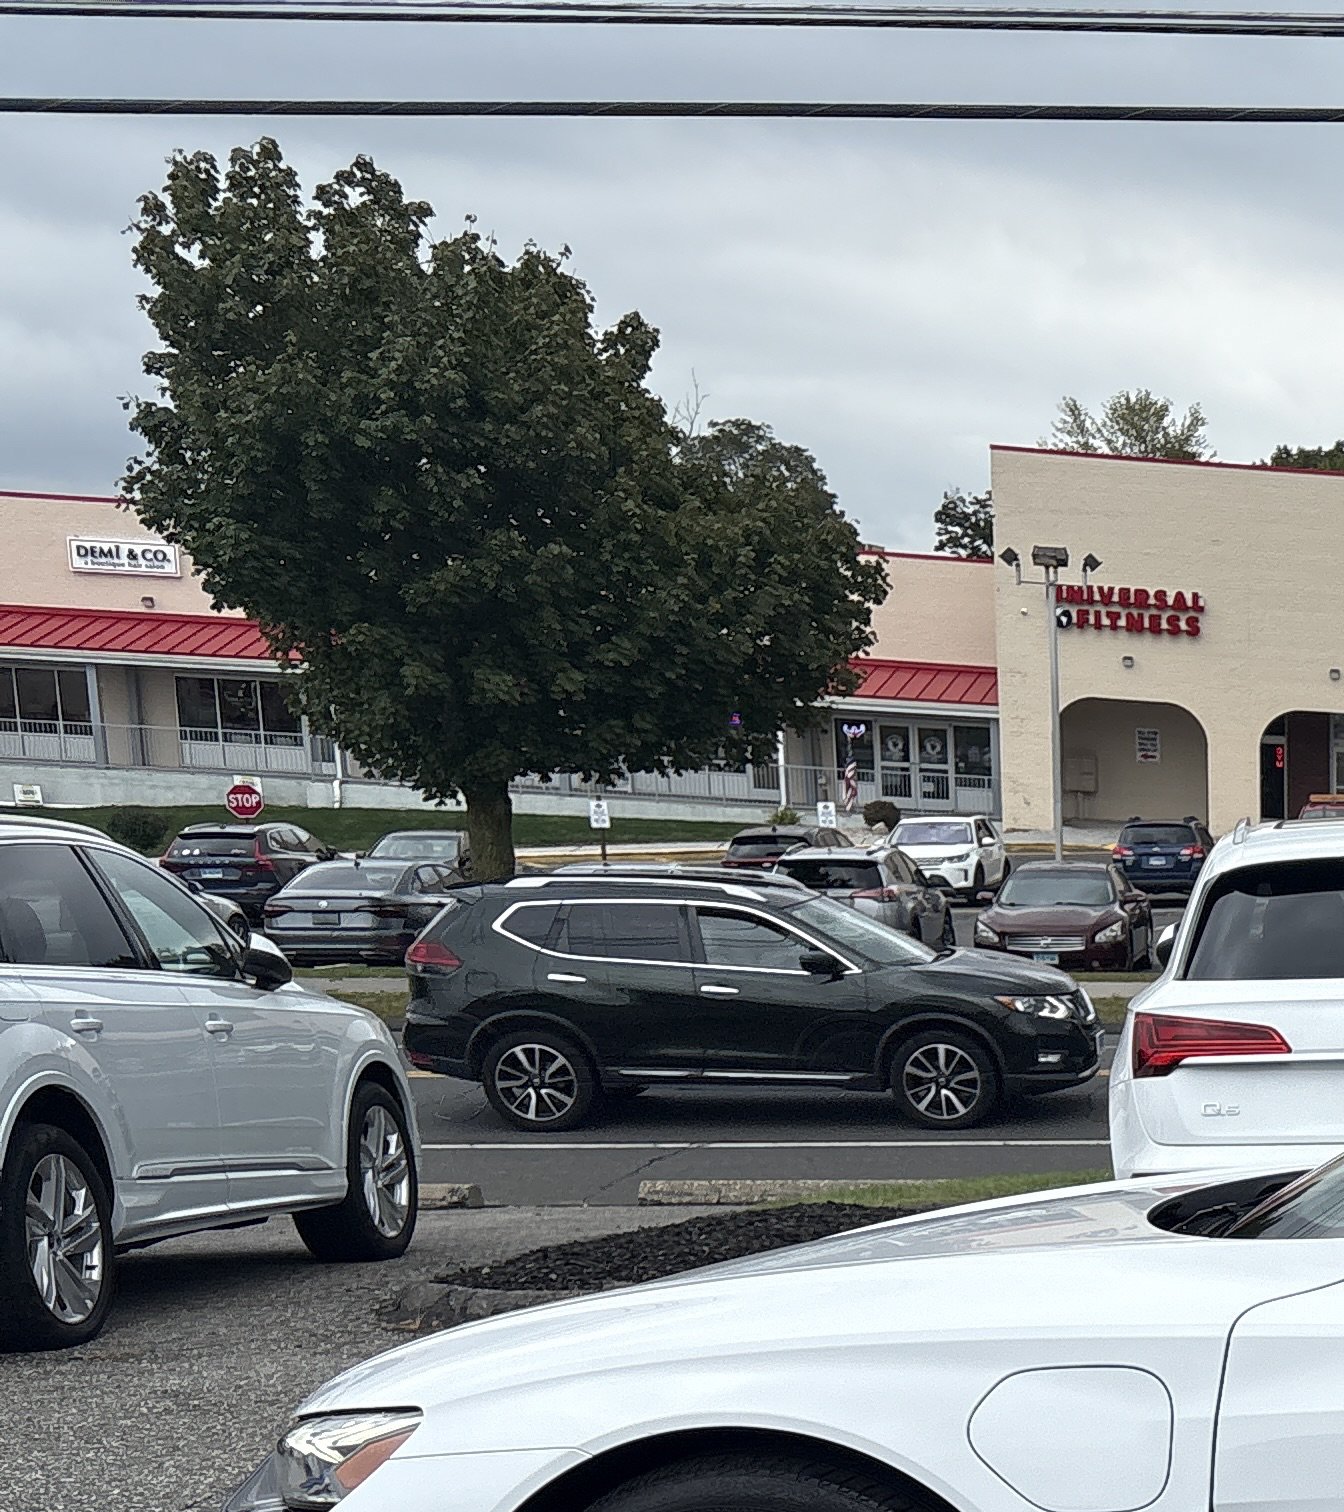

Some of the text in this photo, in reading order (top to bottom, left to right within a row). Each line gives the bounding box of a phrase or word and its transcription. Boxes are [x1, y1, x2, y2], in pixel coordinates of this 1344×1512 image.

[126, 547, 139, 561] &
[140, 548, 172, 563] CO.
[1075, 608, 1201, 637] FITNESS
[227, 792, 260, 809] STOP
[1200, 1102, 1241, 1117] Q5
